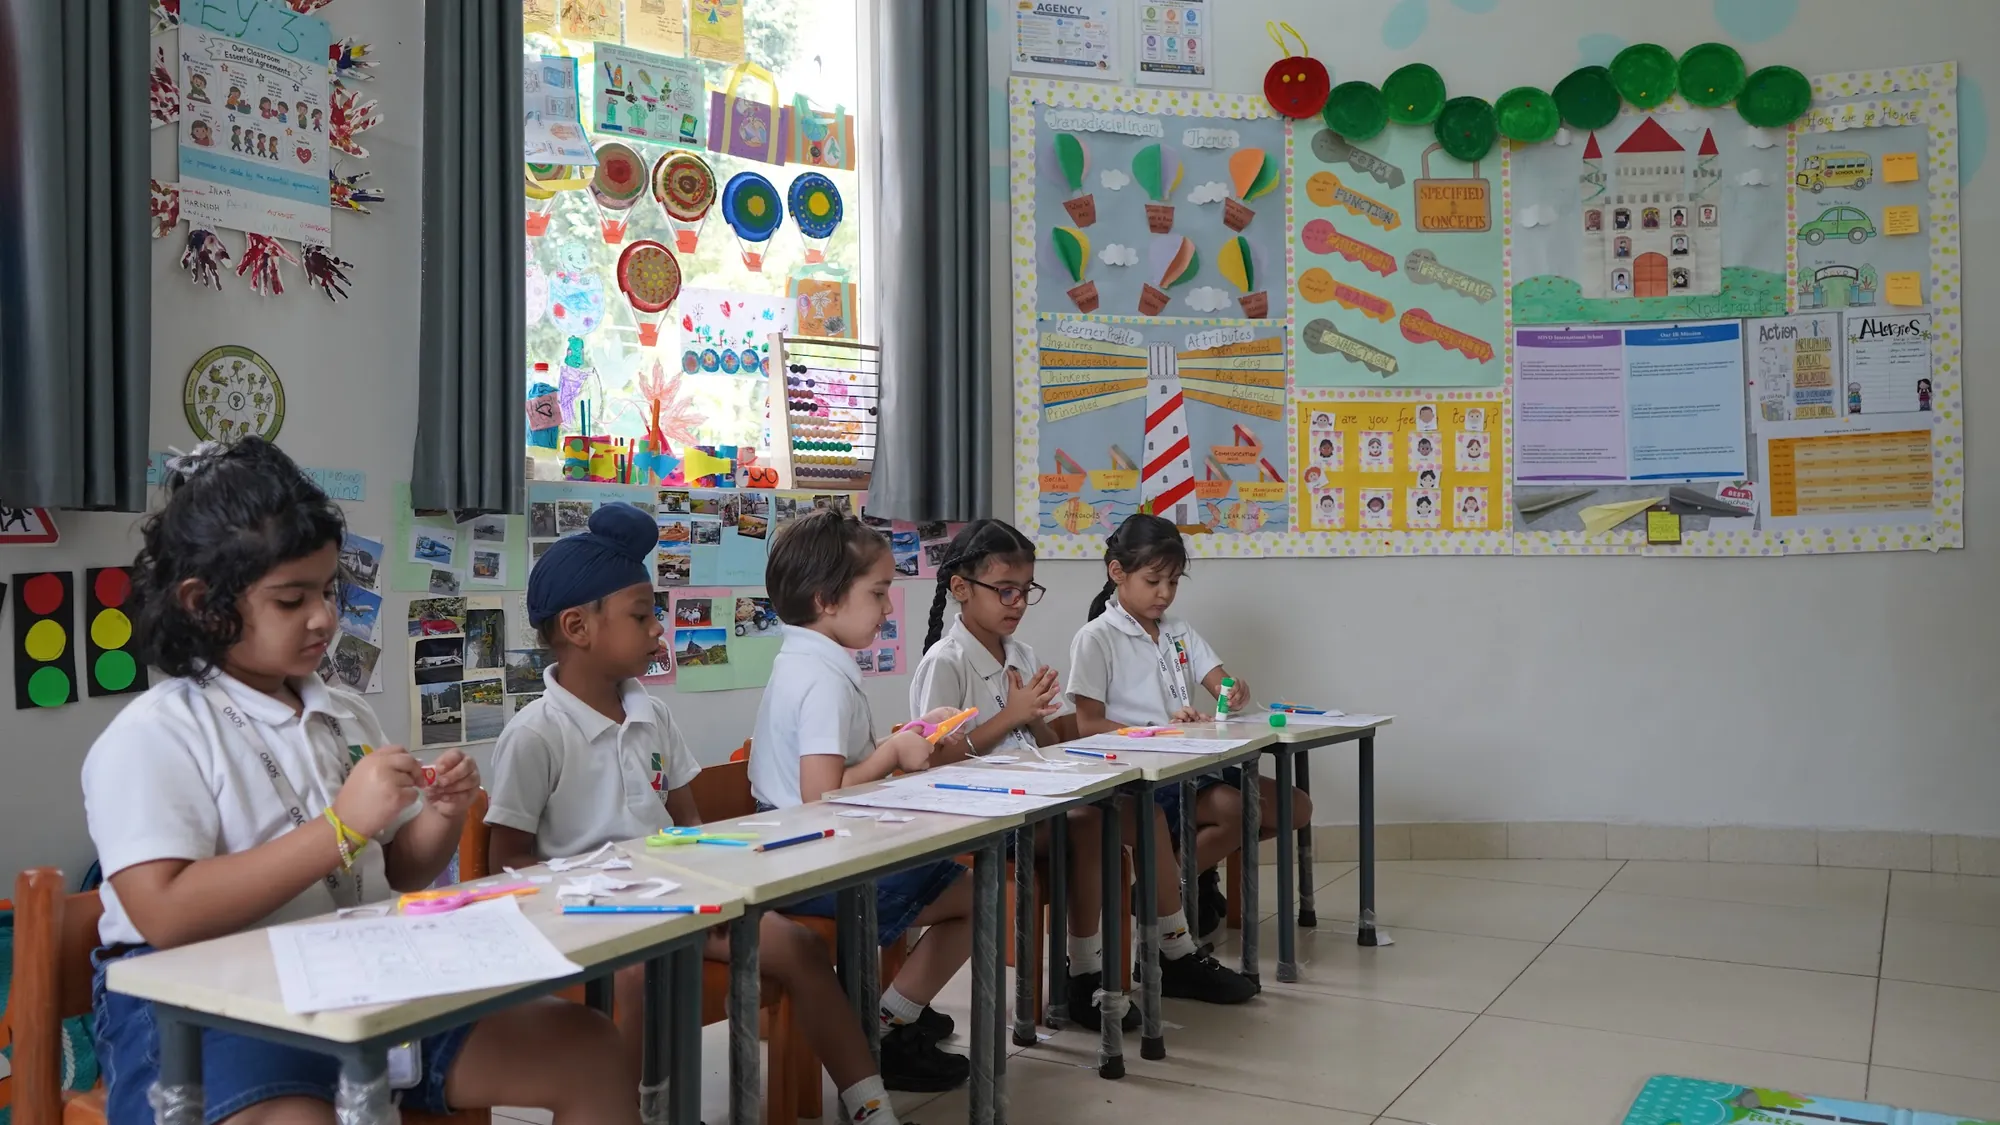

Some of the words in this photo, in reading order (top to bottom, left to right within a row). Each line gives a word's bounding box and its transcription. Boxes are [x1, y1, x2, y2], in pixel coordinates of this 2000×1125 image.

[1036, 3, 1083, 15] AGENCY
[232, 44, 244, 53] Our
[246, 47, 281, 64] Classroom
[224, 50, 254, 63] Essential
[255, 58, 291, 76] Agreements
[1049, 110, 1162, 136] Transdisciplinary
[1188, 129, 1233, 147] Themes
[1348, 151, 1389, 178] FORM
[1420, 186, 1484, 200] SPECIFIED
[1334, 187, 1394, 225] FUNCTION
[1422, 215, 1486, 229] CONCEPTS
[1686, 296, 1784, 318] Kindergarten
[1057, 319, 1105, 337] Learner
[1107, 325, 1134, 345] Profile
[1188, 329, 1252, 348] Attributes
[1759, 323, 1799, 342] Action
[1045, 333, 1093, 350] Inquirers
[1041, 354, 1118, 368] Knowledgeable
[1232, 358, 1261, 369] Caring
[1044, 370, 1091, 384] Thinkers
[1243, 371, 1270, 386] takers
[1043, 383, 1121, 401] Communicators
[1231, 385, 1275, 401] Balanced
[1047, 401, 1099, 420] Principled
[1226, 400, 1273, 417] Reflective
[1341, 414, 1358, 424] are
[1369, 415, 1389, 430] you
[1044, 475, 1066, 483] SOCIAL
[1728, 490, 1746, 498] BEST
[1223, 512, 1260, 520] LEARNING
[223, 705, 246, 729] SOVO
[259, 751, 281, 780] SOVO
